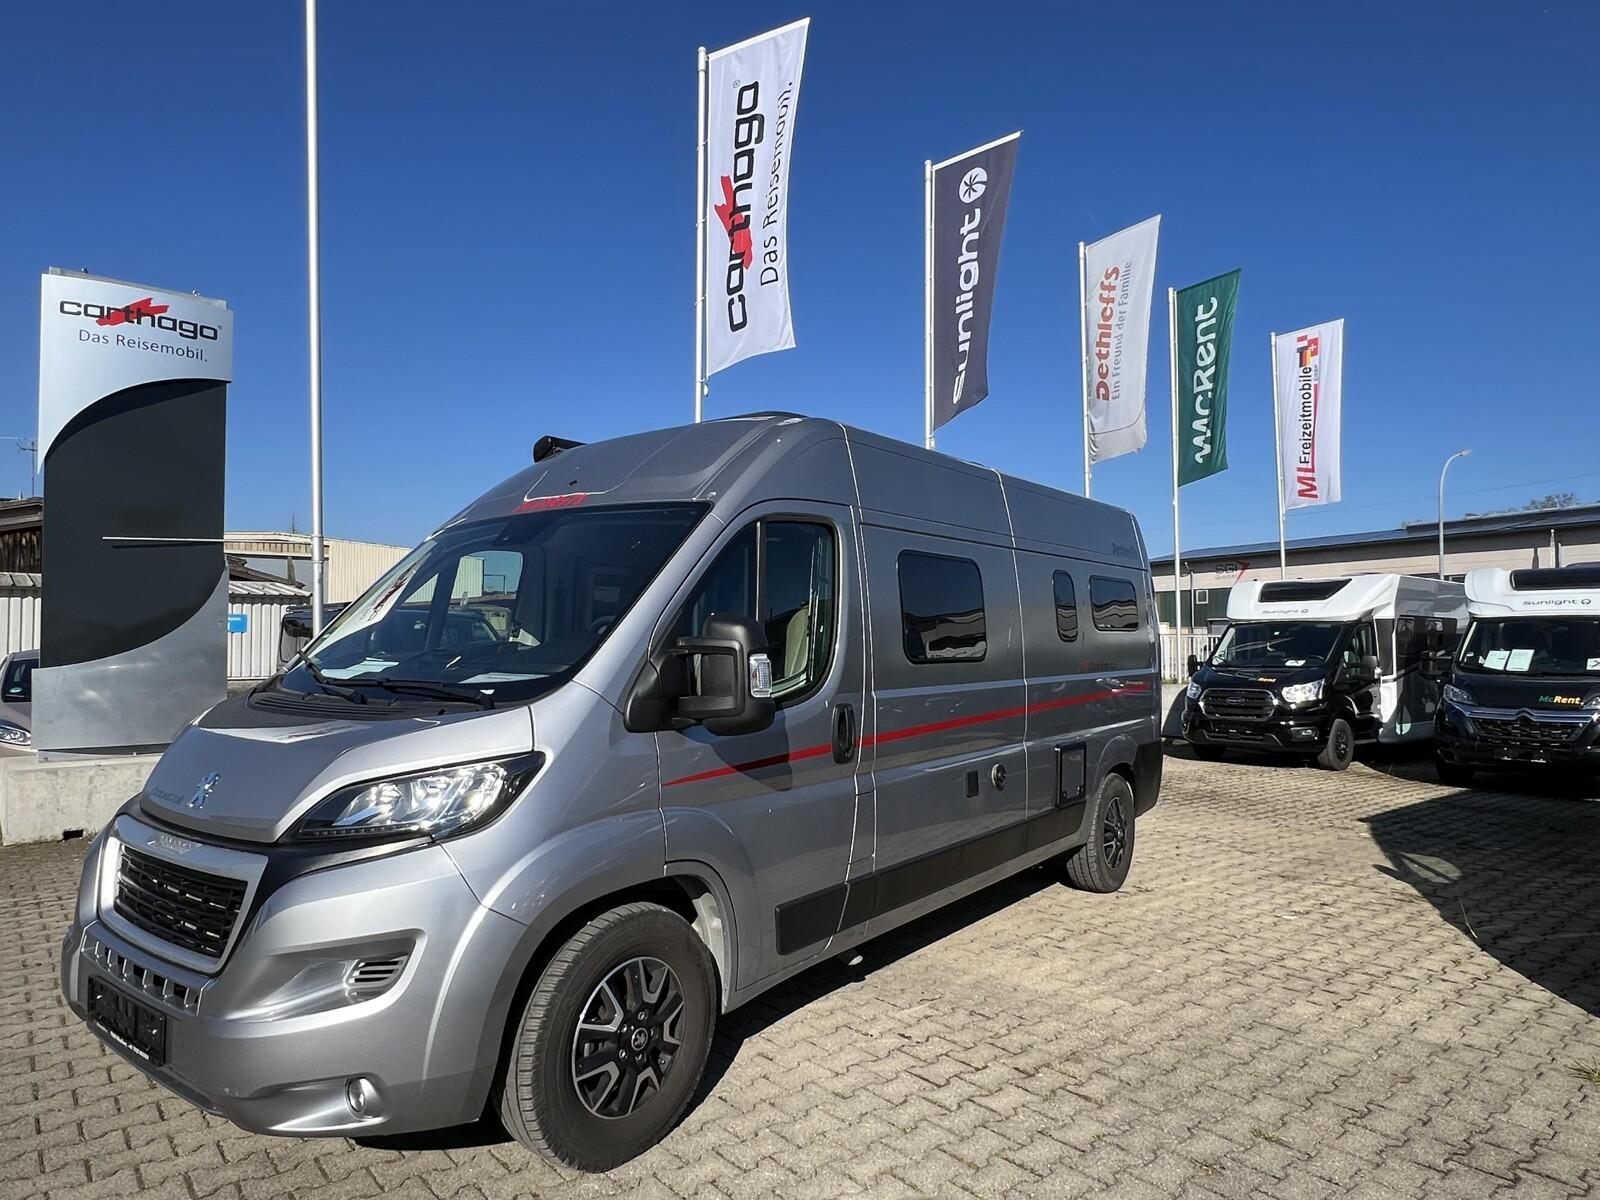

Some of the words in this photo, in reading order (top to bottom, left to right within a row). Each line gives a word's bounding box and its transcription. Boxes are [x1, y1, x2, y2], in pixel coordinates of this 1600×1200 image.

[726, 80, 764, 332] carthago
[760, 237, 778, 286] Das
[1119, 261, 1132, 307] Familie
[59, 300, 218, 341] carthago
[953, 208, 981, 404] sunlight
[1116, 309, 1127, 332] der
[79, 329, 109, 344] Das
[116, 334, 208, 362] Reisemobil.
[1095, 265, 1120, 401] Dethleffs
[1112, 332, 1123, 377] Freund
[1112, 379, 1120, 400] Ein
[1299, 366, 1313, 464] Freizeitmobile
[1297, 467, 1319, 499] ML
[1539, 695, 1581, 705] McRent
